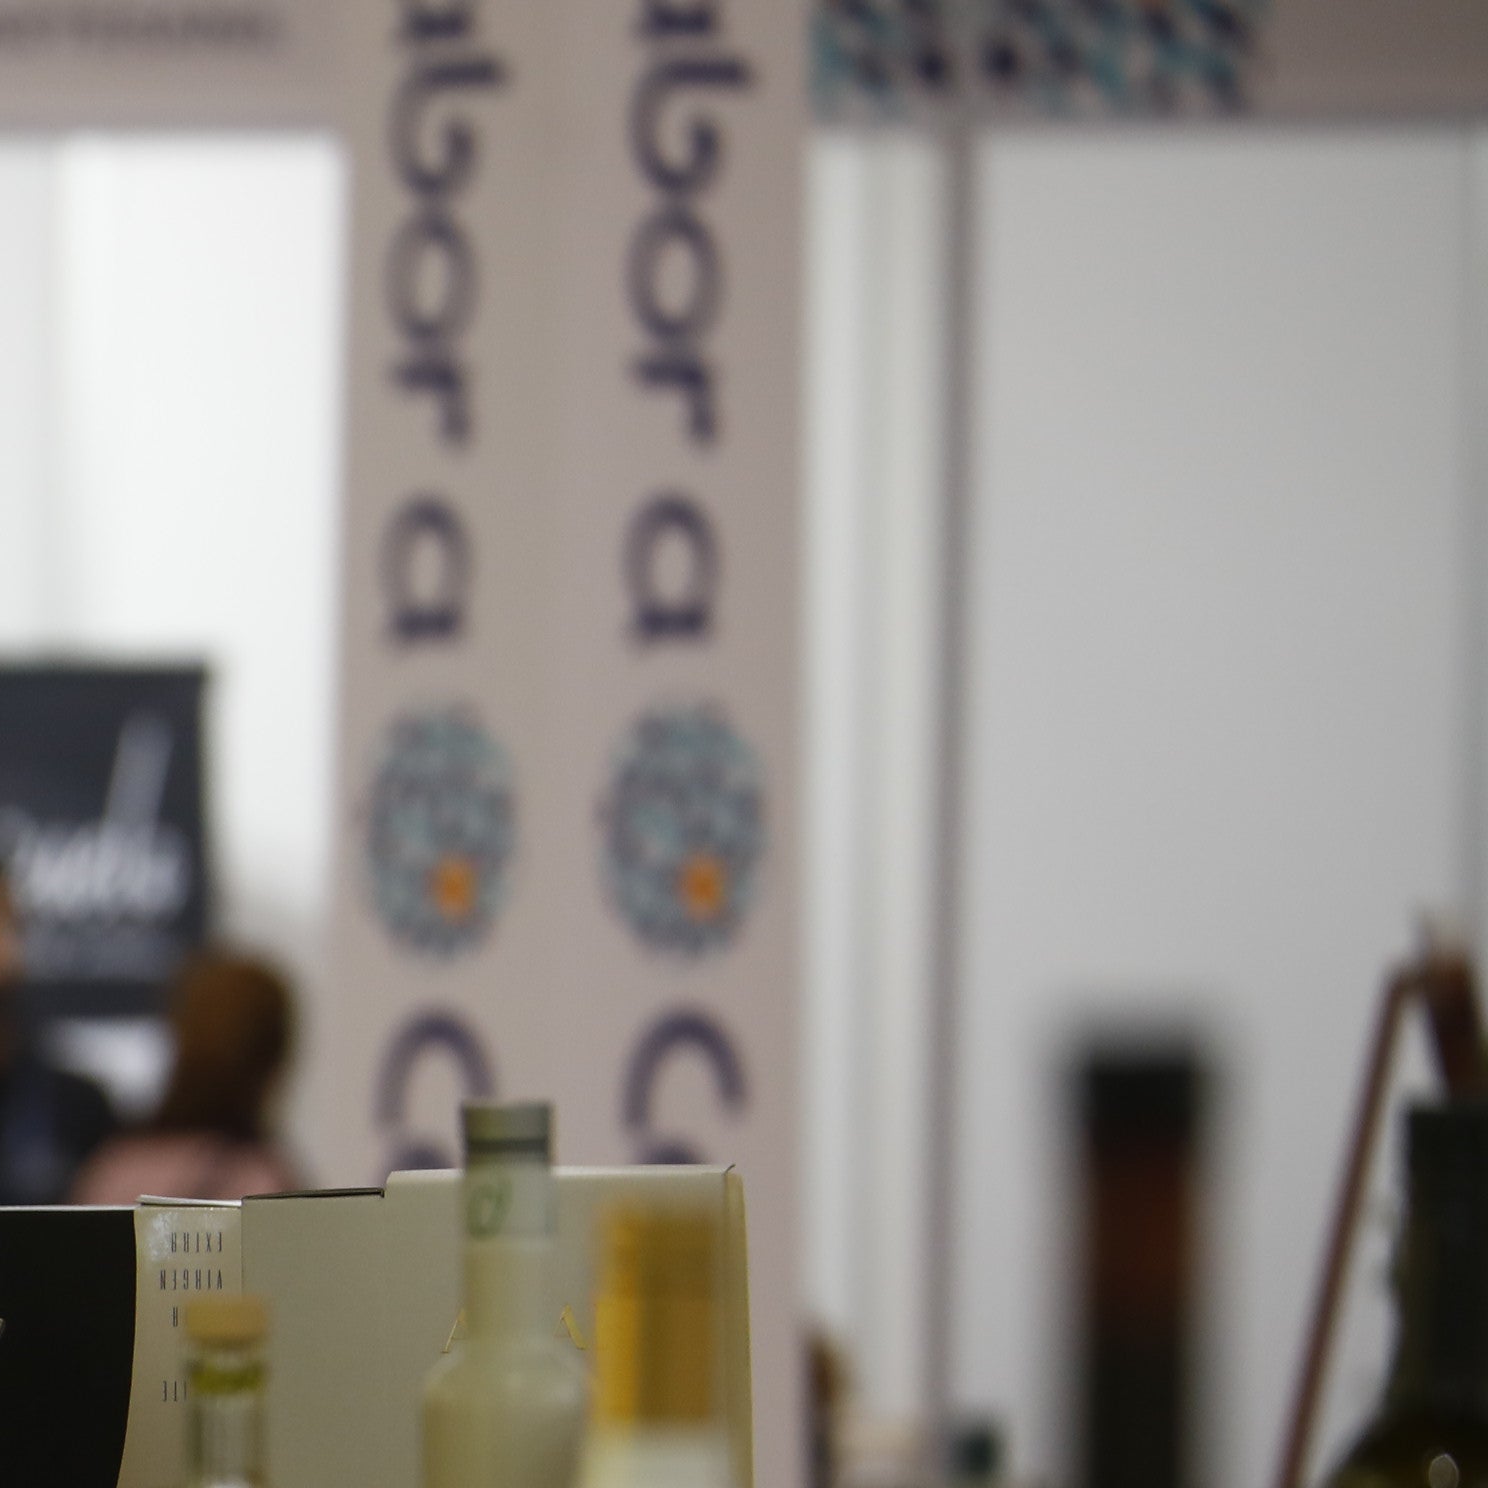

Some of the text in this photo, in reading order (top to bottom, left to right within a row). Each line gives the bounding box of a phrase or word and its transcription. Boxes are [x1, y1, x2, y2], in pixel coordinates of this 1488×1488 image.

[381, 493, 477, 650] a
[624, 490, 722, 650] a
[159, 1268, 223, 1291] VIRGEN
[171, 1231, 223, 1253] EXTRA
